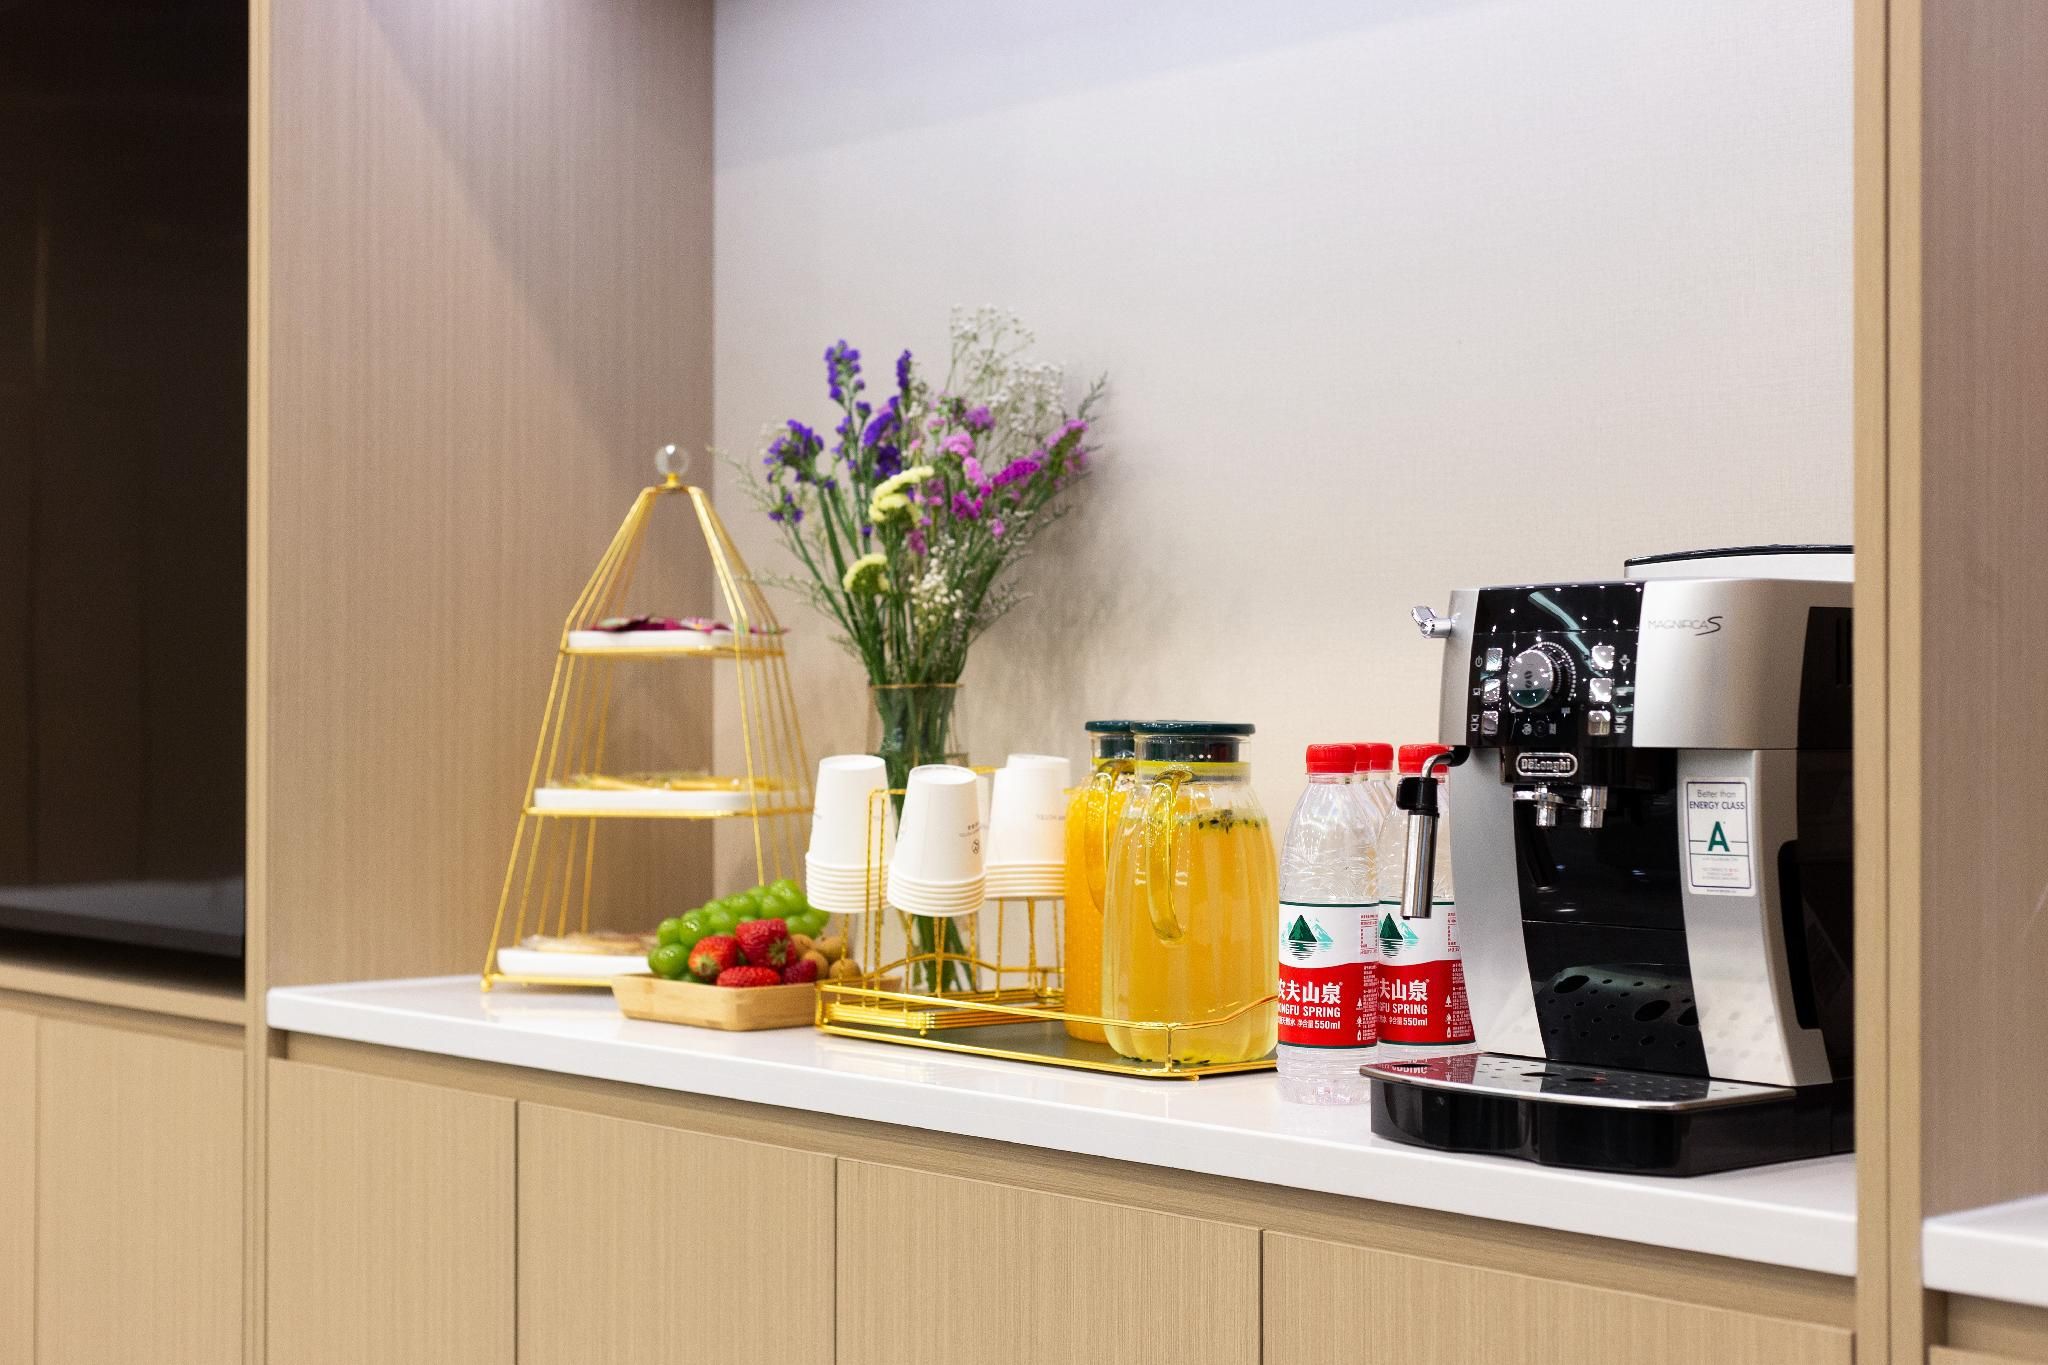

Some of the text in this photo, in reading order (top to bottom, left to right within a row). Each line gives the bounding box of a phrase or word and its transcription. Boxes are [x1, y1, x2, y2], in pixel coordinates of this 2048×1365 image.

[1697, 789, 1718, 798] Better
[1689, 801, 1745, 810] ENERGY CLASS
[1303, 1006, 1340, 1018] SPRING
[1392, 1003, 1428, 1015] SPRING
